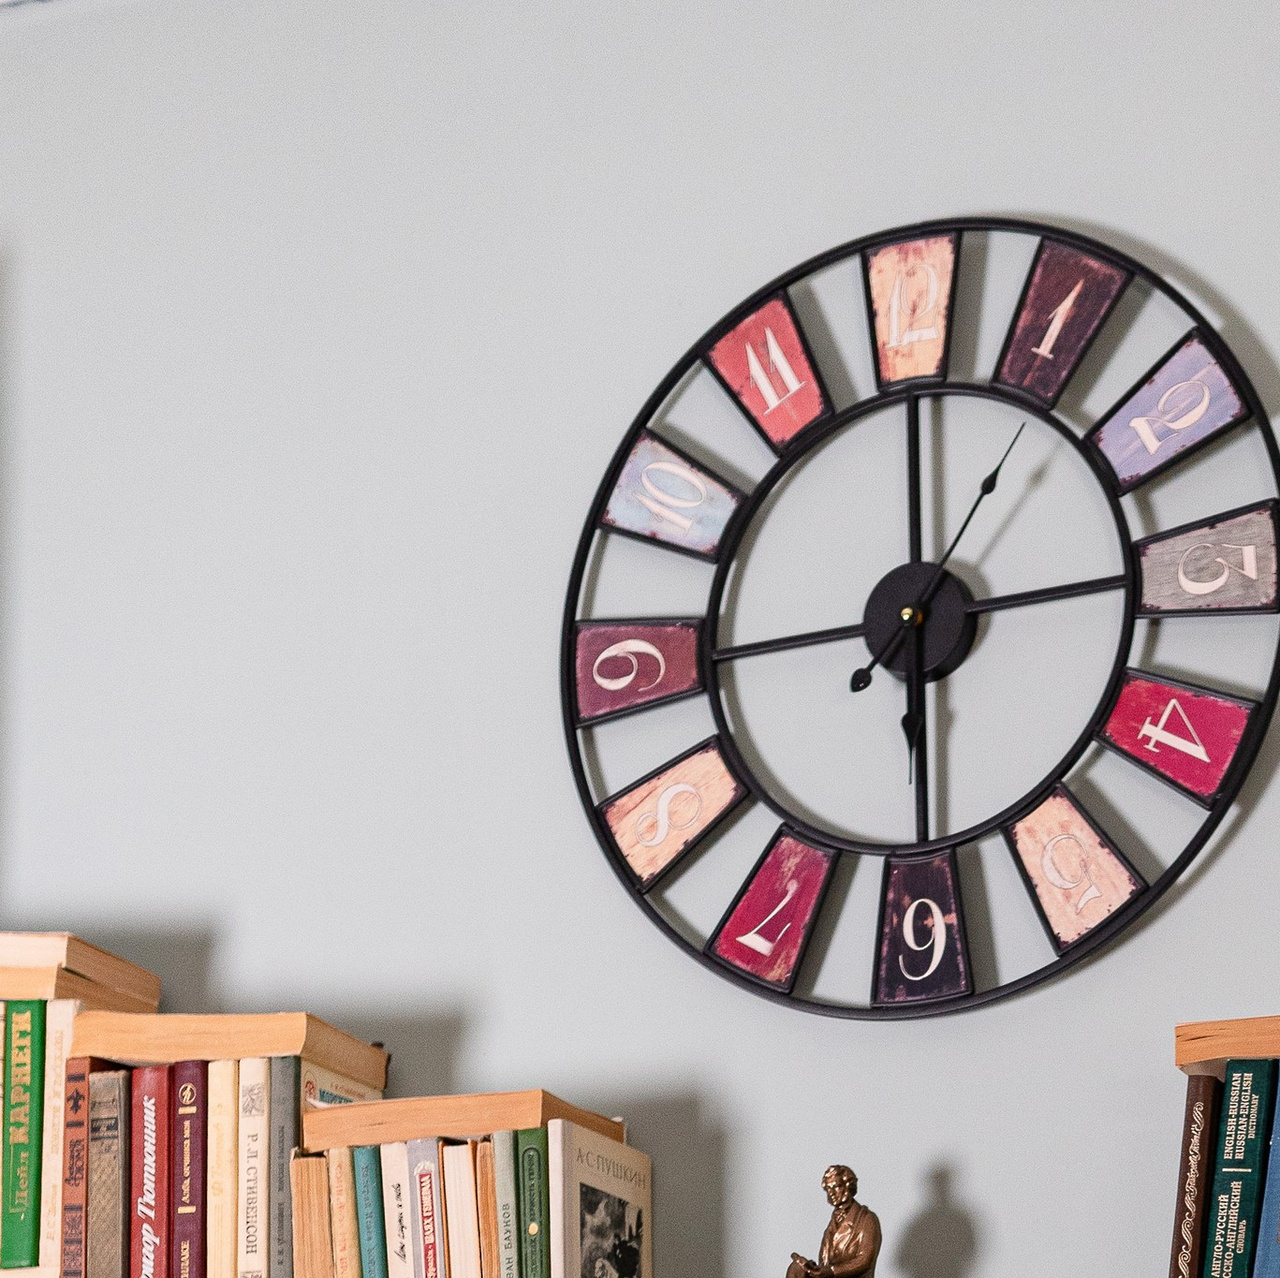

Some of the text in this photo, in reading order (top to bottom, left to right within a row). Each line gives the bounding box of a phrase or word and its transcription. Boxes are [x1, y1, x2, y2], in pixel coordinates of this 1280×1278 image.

[887, 262, 940, 353] 12
[1031, 278, 1084, 360] 1
[744, 326, 809, 418] 11
[1128, 379, 1213, 457] 2
[635, 459, 708, 534] 10
[1177, 542, 1258, 596] 3
[592, 638, 667, 692] 9
[1137, 698, 1213, 765] 4
[635, 781, 704, 850] 8
[1041, 833, 1103, 916] 5
[735, 880, 799, 958] 7
[898, 896, 948, 982] 6
[9, 1010, 32, 1146] КАРНЕГИ
[1223, 1072, 1242, 1159] ENGLISH-RUSSIAN
[1234, 1072, 1253, 1160] RUSSIAN-ENGLISH
[1247, 1093, 1259, 1139] DICTIONARY
[137, 1094, 158, 1221] Тютюнник
[1211, 1194, 1229, 1278] АНГЛО-РУССКИЙ
[1236, 1219, 1247, 1254] СЛОВАРЬ
